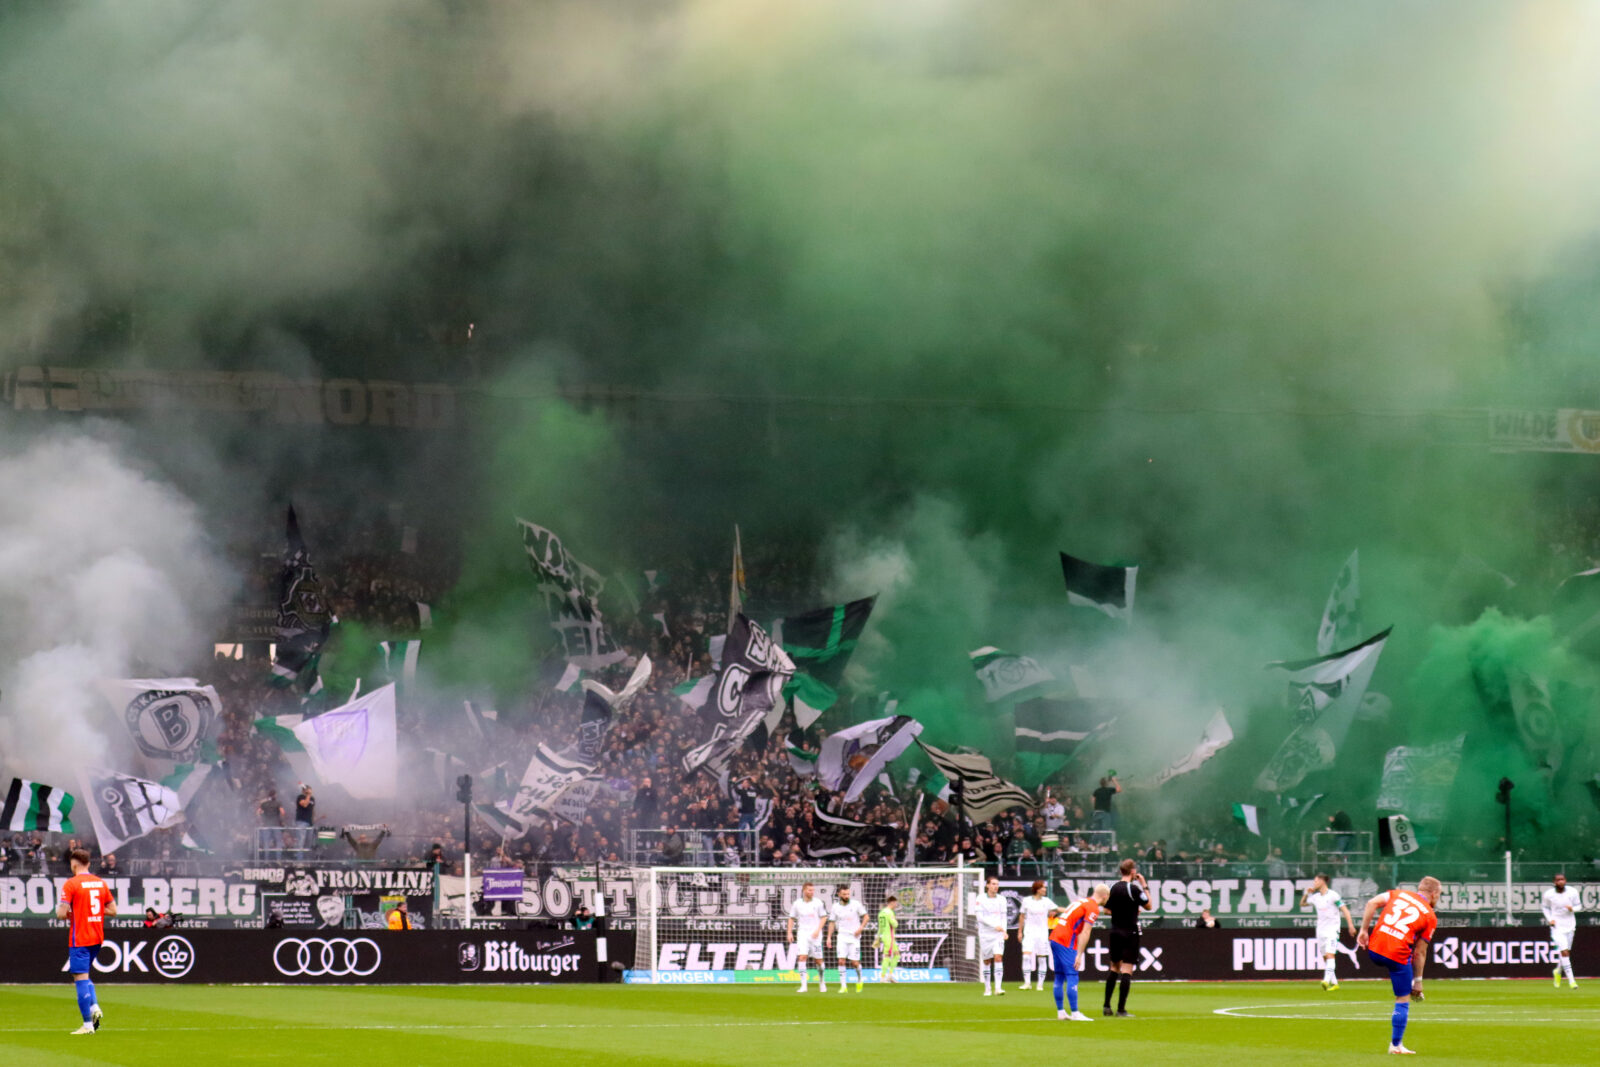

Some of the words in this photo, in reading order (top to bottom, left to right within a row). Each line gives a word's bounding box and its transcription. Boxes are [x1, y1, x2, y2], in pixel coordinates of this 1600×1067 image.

[315, 870, 433, 889] FRONTLINE
[89, 889, 101, 915] 5
[1384, 898, 1420, 934] 32
[482, 940, 581, 976] Bitburger
[1232, 938, 1326, 970] PUMA
[871, 970, 930, 981] JNGEN
